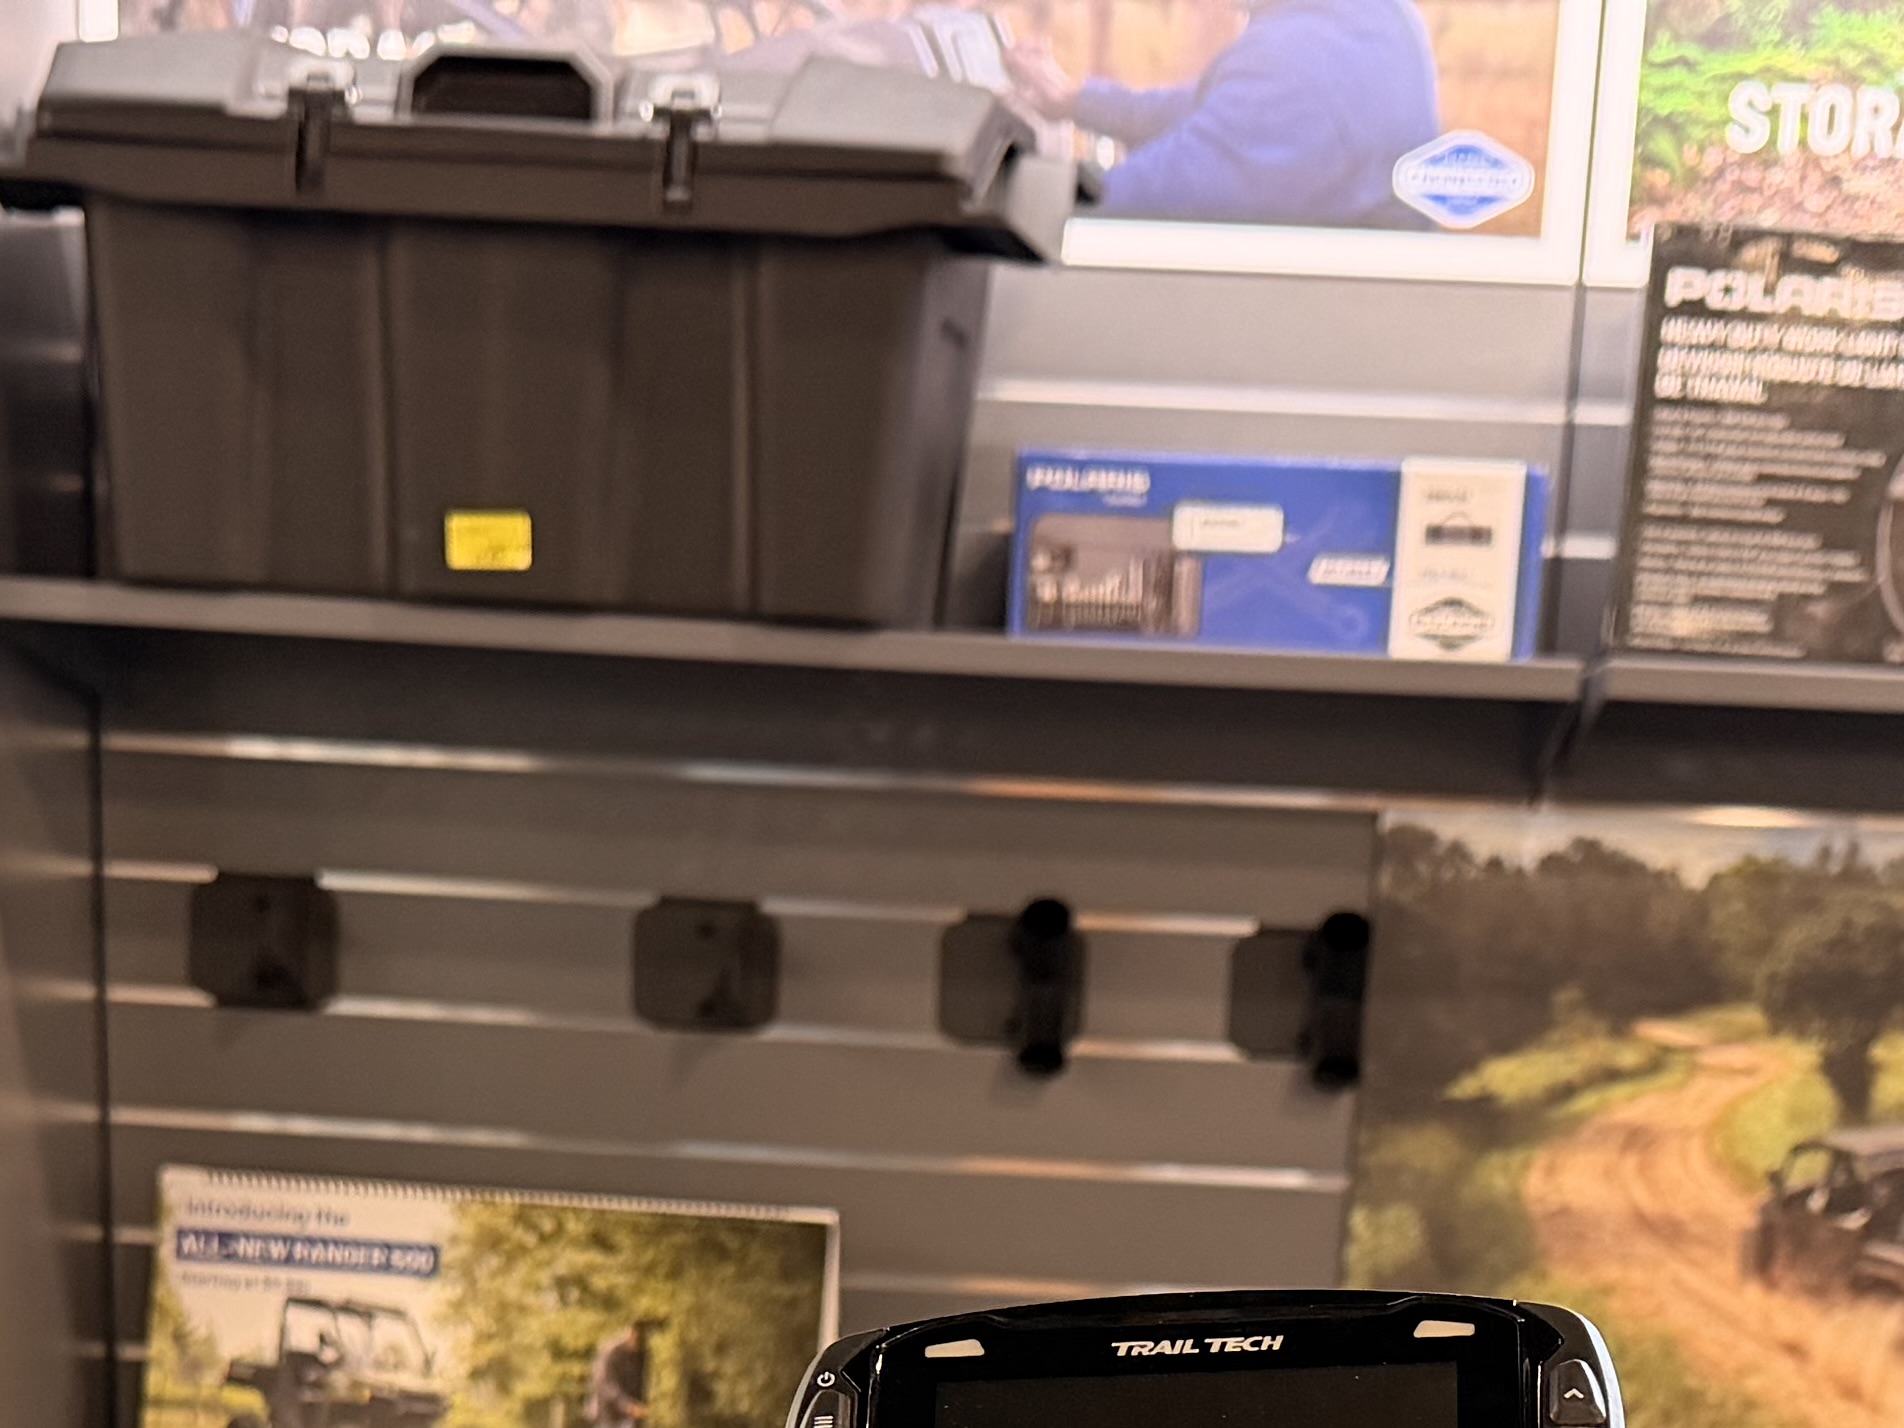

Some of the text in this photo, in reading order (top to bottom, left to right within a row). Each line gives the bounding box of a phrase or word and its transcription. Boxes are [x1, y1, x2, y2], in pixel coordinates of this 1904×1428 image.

[189, 1198, 309, 1230] Introducing
[181, 1232, 291, 1263] ALL-NEW
[293, 1240, 389, 1268] RANGER
[1111, 1335, 1284, 1356] TRAIL TECH
